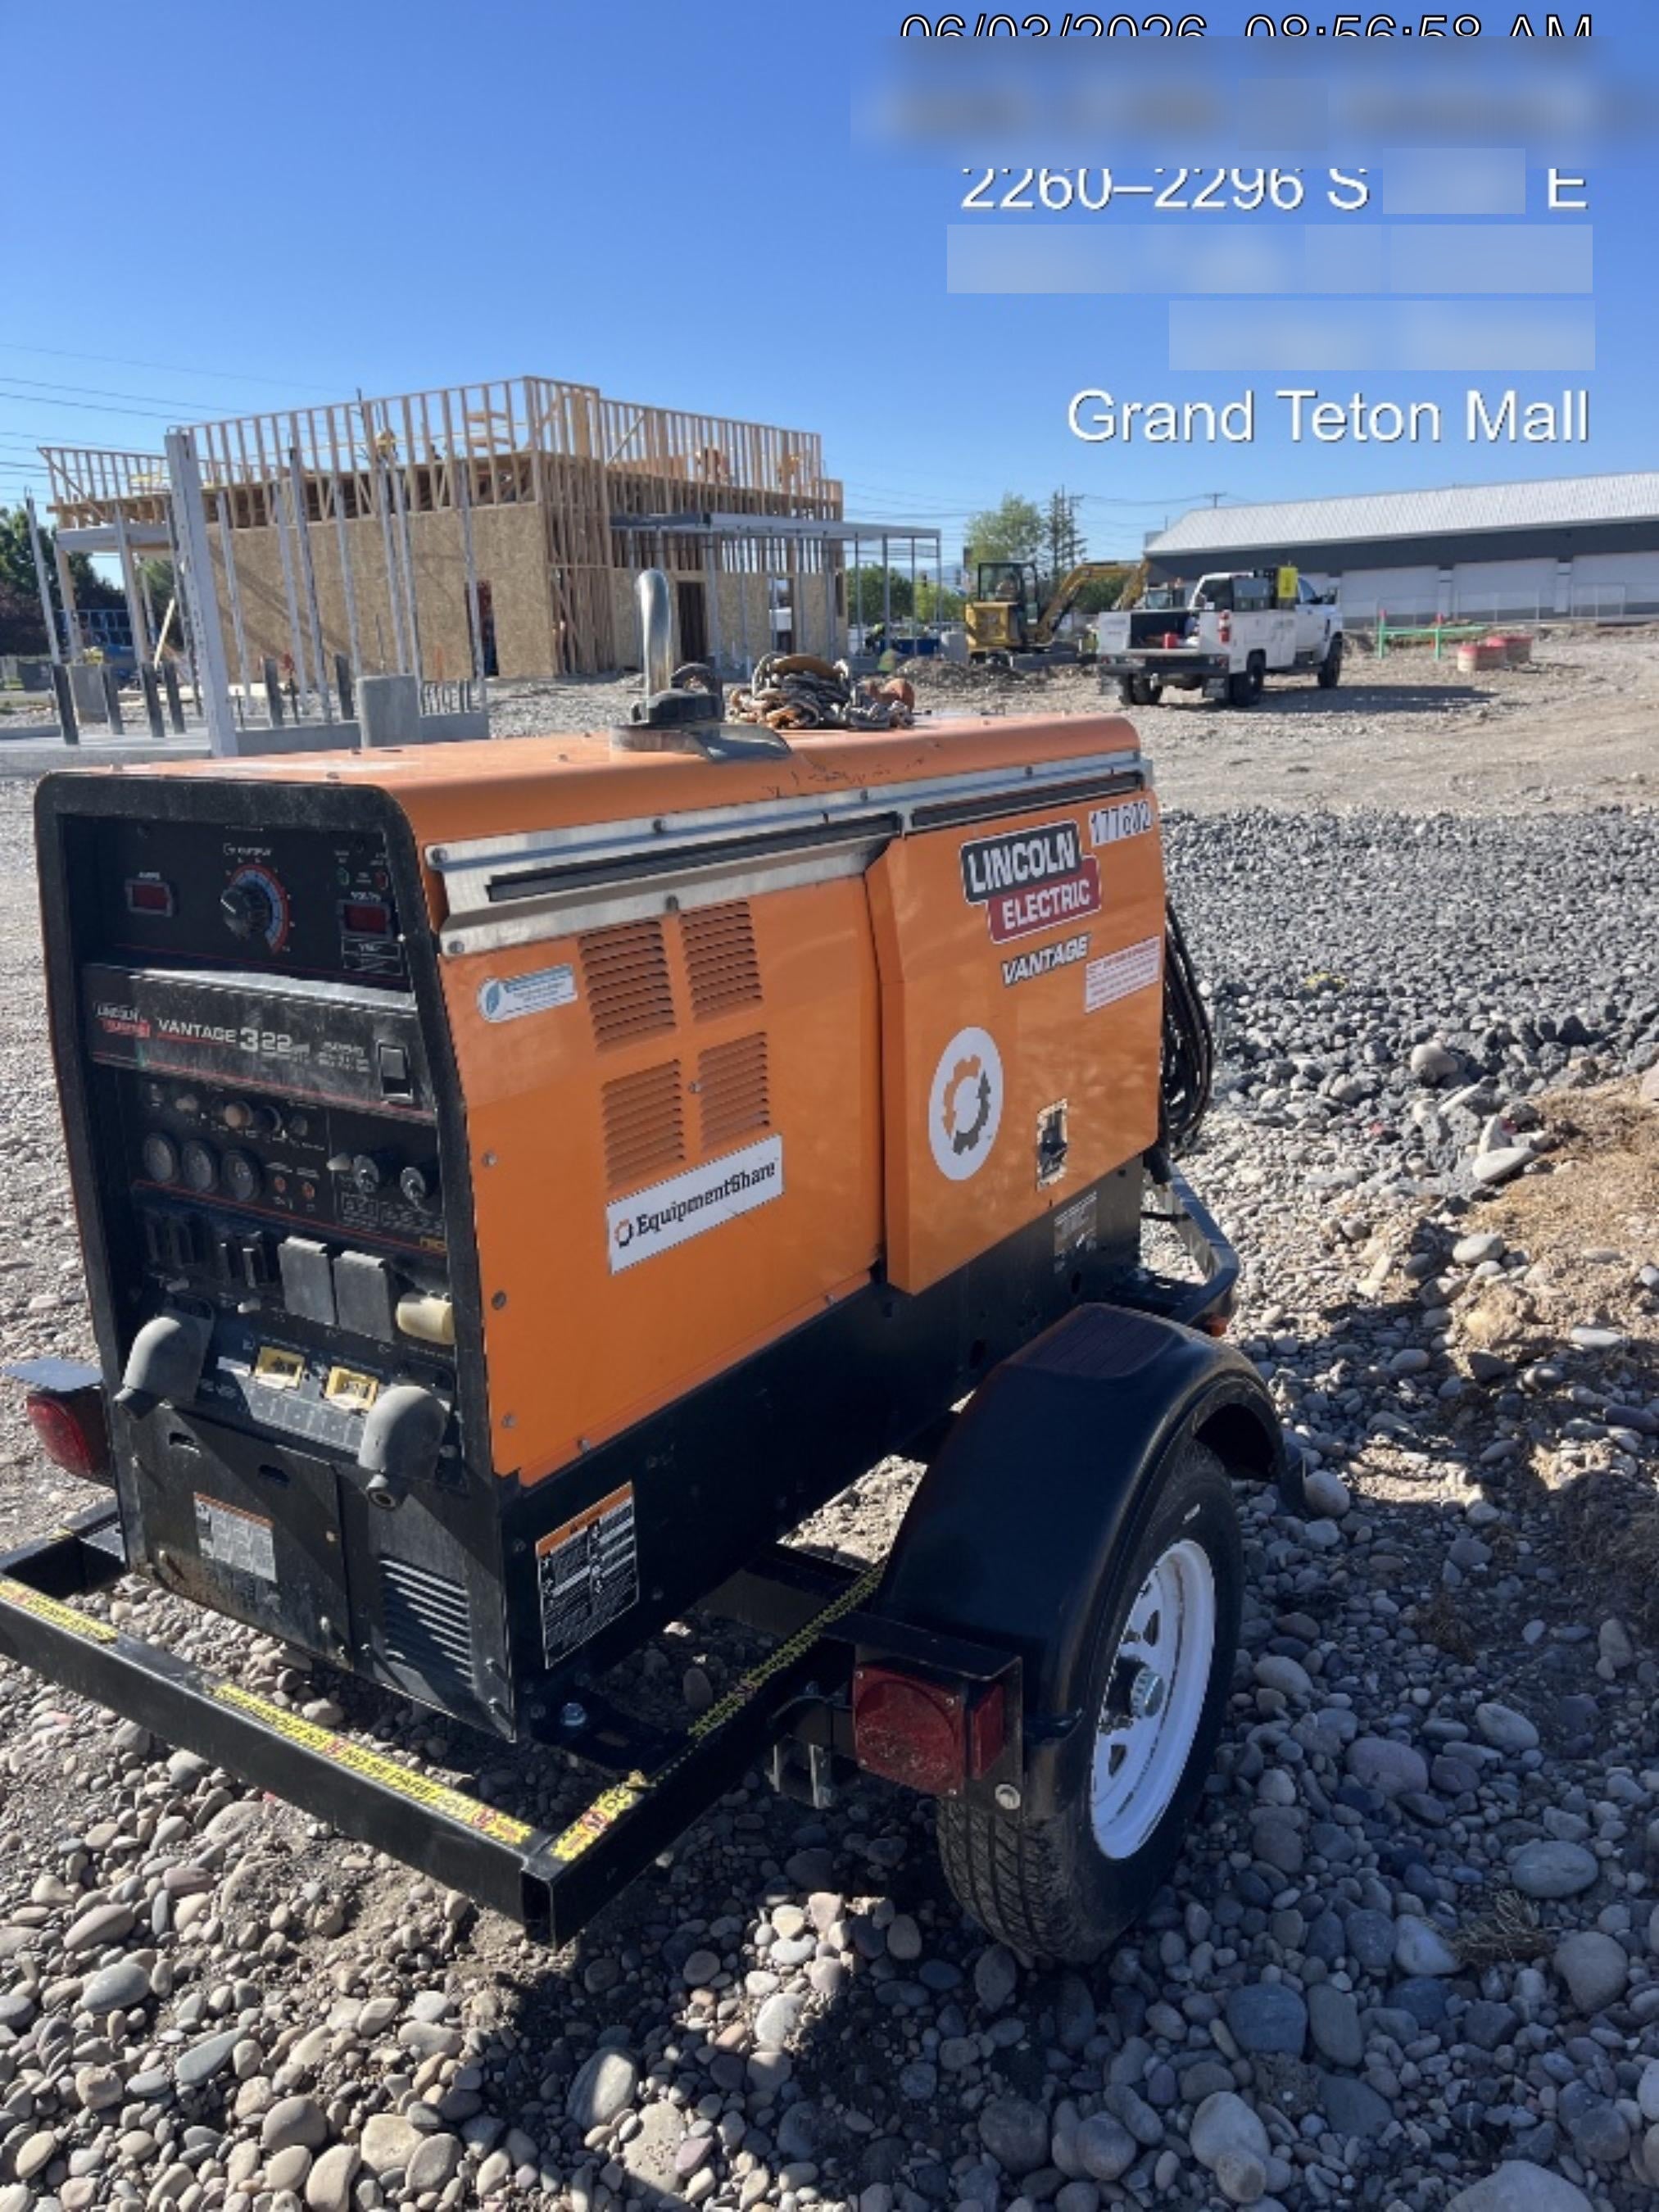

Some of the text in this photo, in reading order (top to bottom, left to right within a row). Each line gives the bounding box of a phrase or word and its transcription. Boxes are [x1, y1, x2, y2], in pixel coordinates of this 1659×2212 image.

[968, 830, 1076, 894] LINCOLN
[1002, 878, 1090, 931] ELECTRIC
[1002, 934, 1090, 985] VANTAGE
[157, 1018, 237, 1044] VANTAGE
[239, 1027, 292, 1054] 322
[635, 1162, 775, 1236] EquipmentShare
